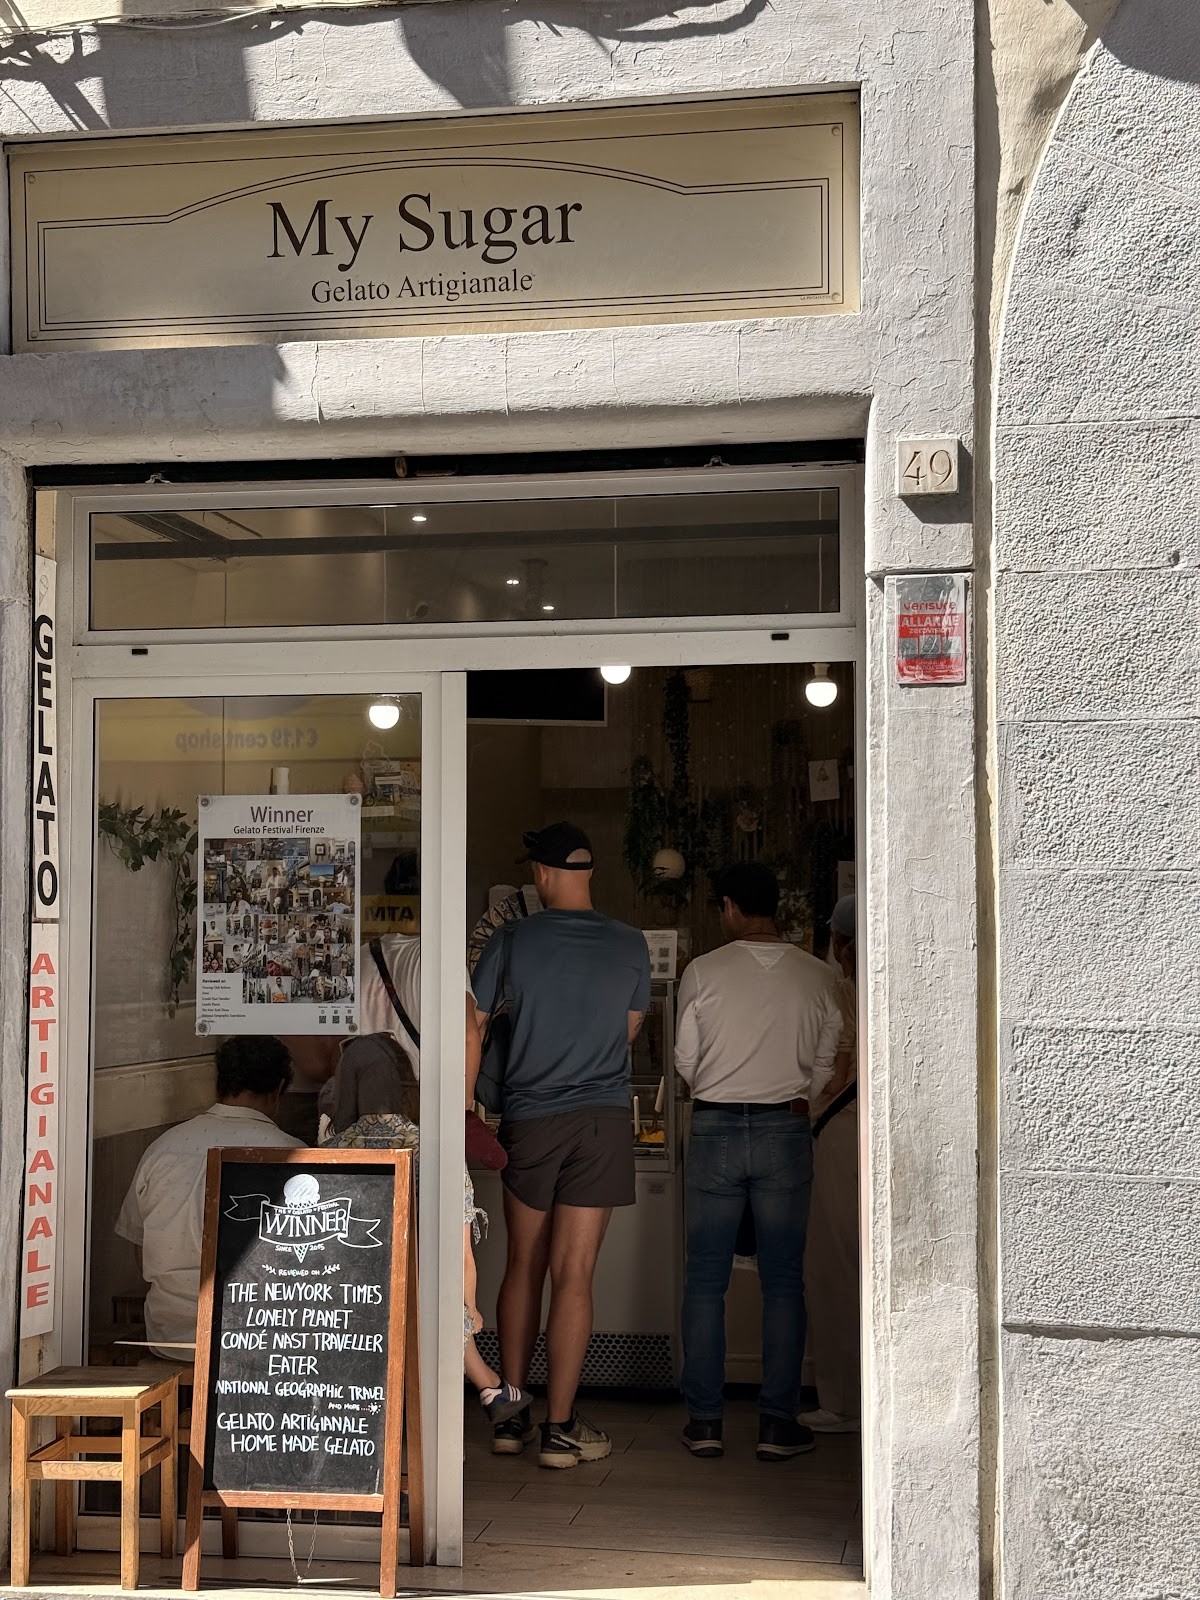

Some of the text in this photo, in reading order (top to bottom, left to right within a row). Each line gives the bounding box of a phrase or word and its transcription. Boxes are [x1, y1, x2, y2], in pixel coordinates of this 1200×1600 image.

[266, 193, 583, 272] My Sugar
[311, 268, 534, 304] Gelato Artigianale
[903, 450, 955, 488] 49
[903, 602, 957, 610] verisure
[902, 615, 960, 627] ALLARME
[34, 614, 58, 907] GELATO
[250, 805, 314, 823] Winner
[233, 824, 325, 835] Gelato Festival Firenze
[26, 953, 57, 1309] ARTIGIANALE
[264, 1209, 347, 1237] WINNER
[227, 1282, 383, 1305] THE NEWYORK TIMES
[246, 1306, 354, 1330] LONELY PLANET
[220, 1328, 384, 1353] CONDÉ NAST TRAVELLER
[268, 1354, 319, 1376] EATER
[215, 1380, 272, 1396] NATIONAL
[347, 1385, 386, 1401] TRAVEL
[327, 1401, 342, 1410] AND
[216, 1412, 275, 1432] GELATO
[230, 1433, 375, 1457] HOME MADE GELATO
